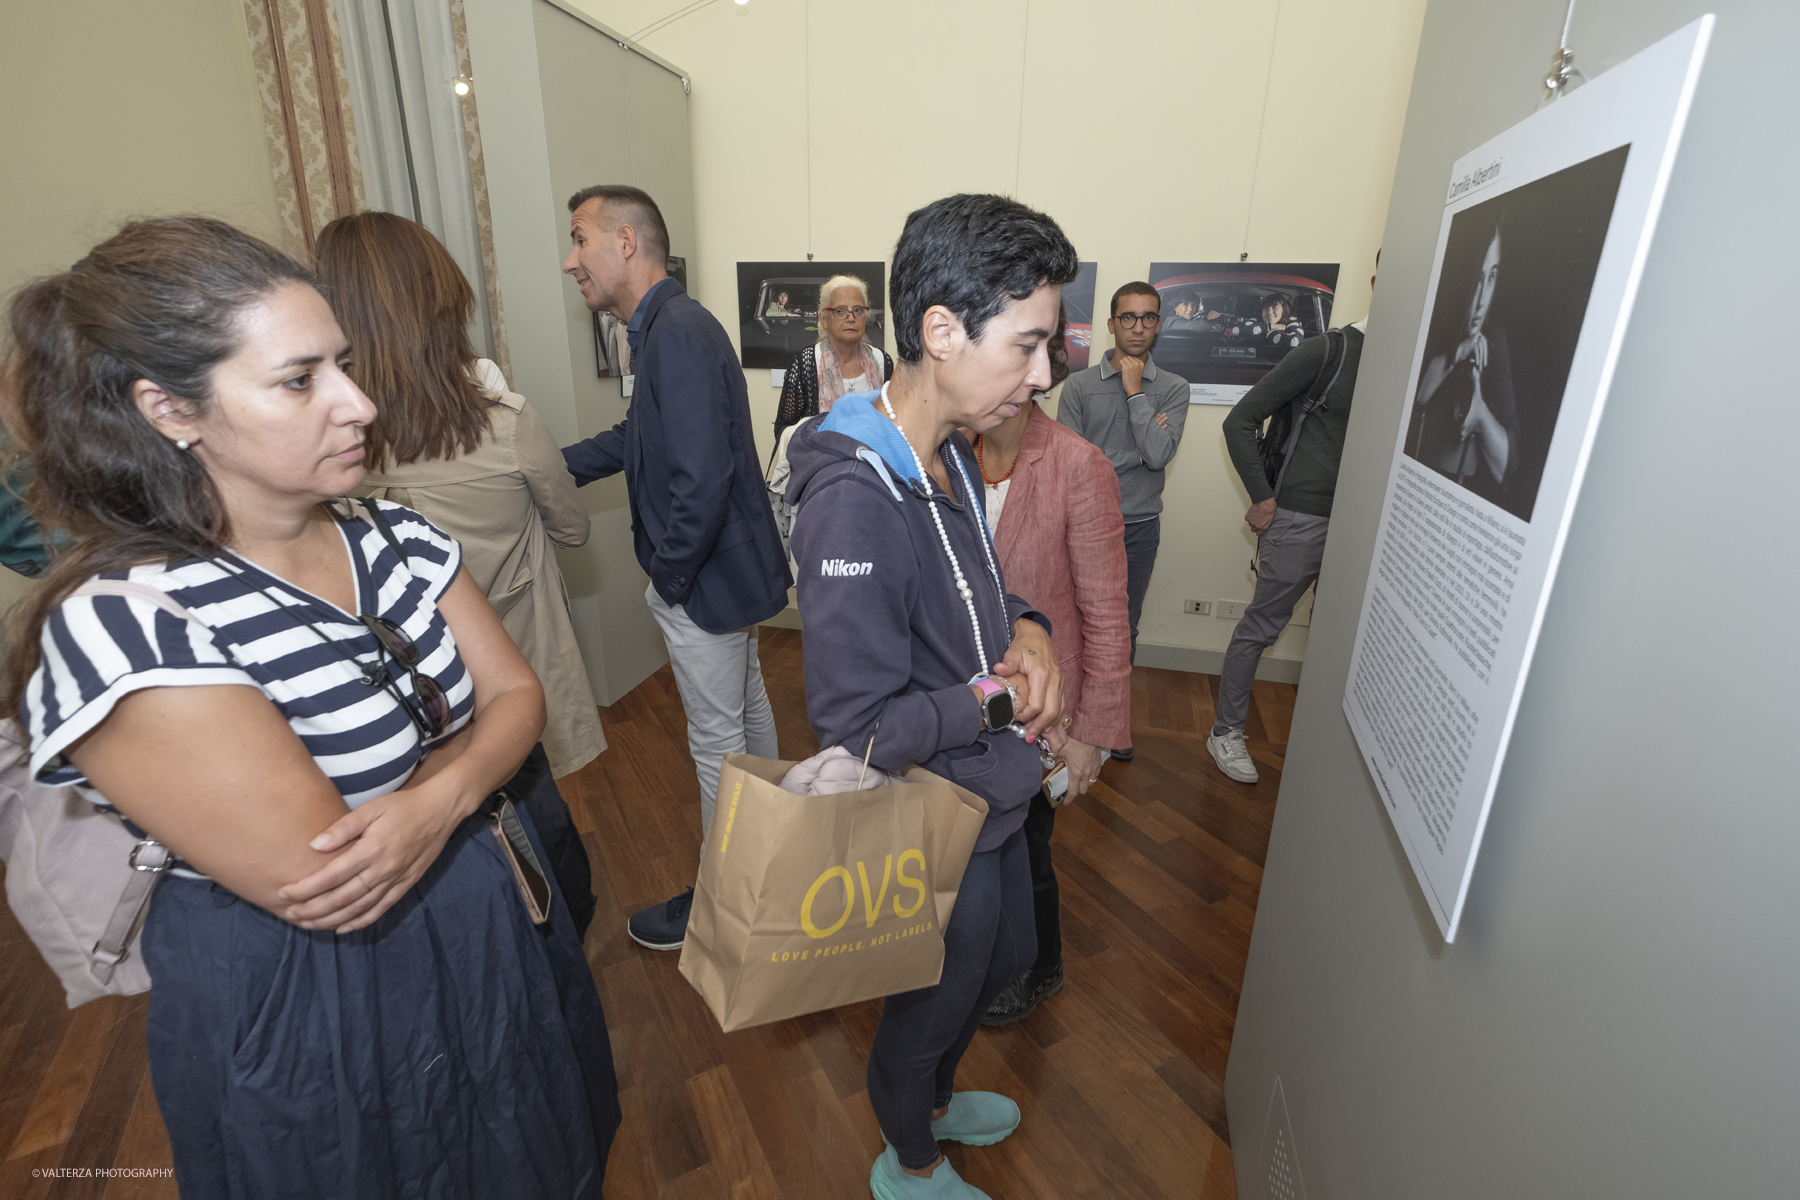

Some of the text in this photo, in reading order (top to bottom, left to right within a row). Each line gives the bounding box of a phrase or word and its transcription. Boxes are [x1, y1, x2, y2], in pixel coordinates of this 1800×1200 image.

[1450, 155, 1503, 198] Camilla Albertini
[821, 558, 873, 577] Nikon
[800, 848, 926, 939] OVS
[771, 921, 935, 963] LOVE PEOPLE. NOT LABELS.
